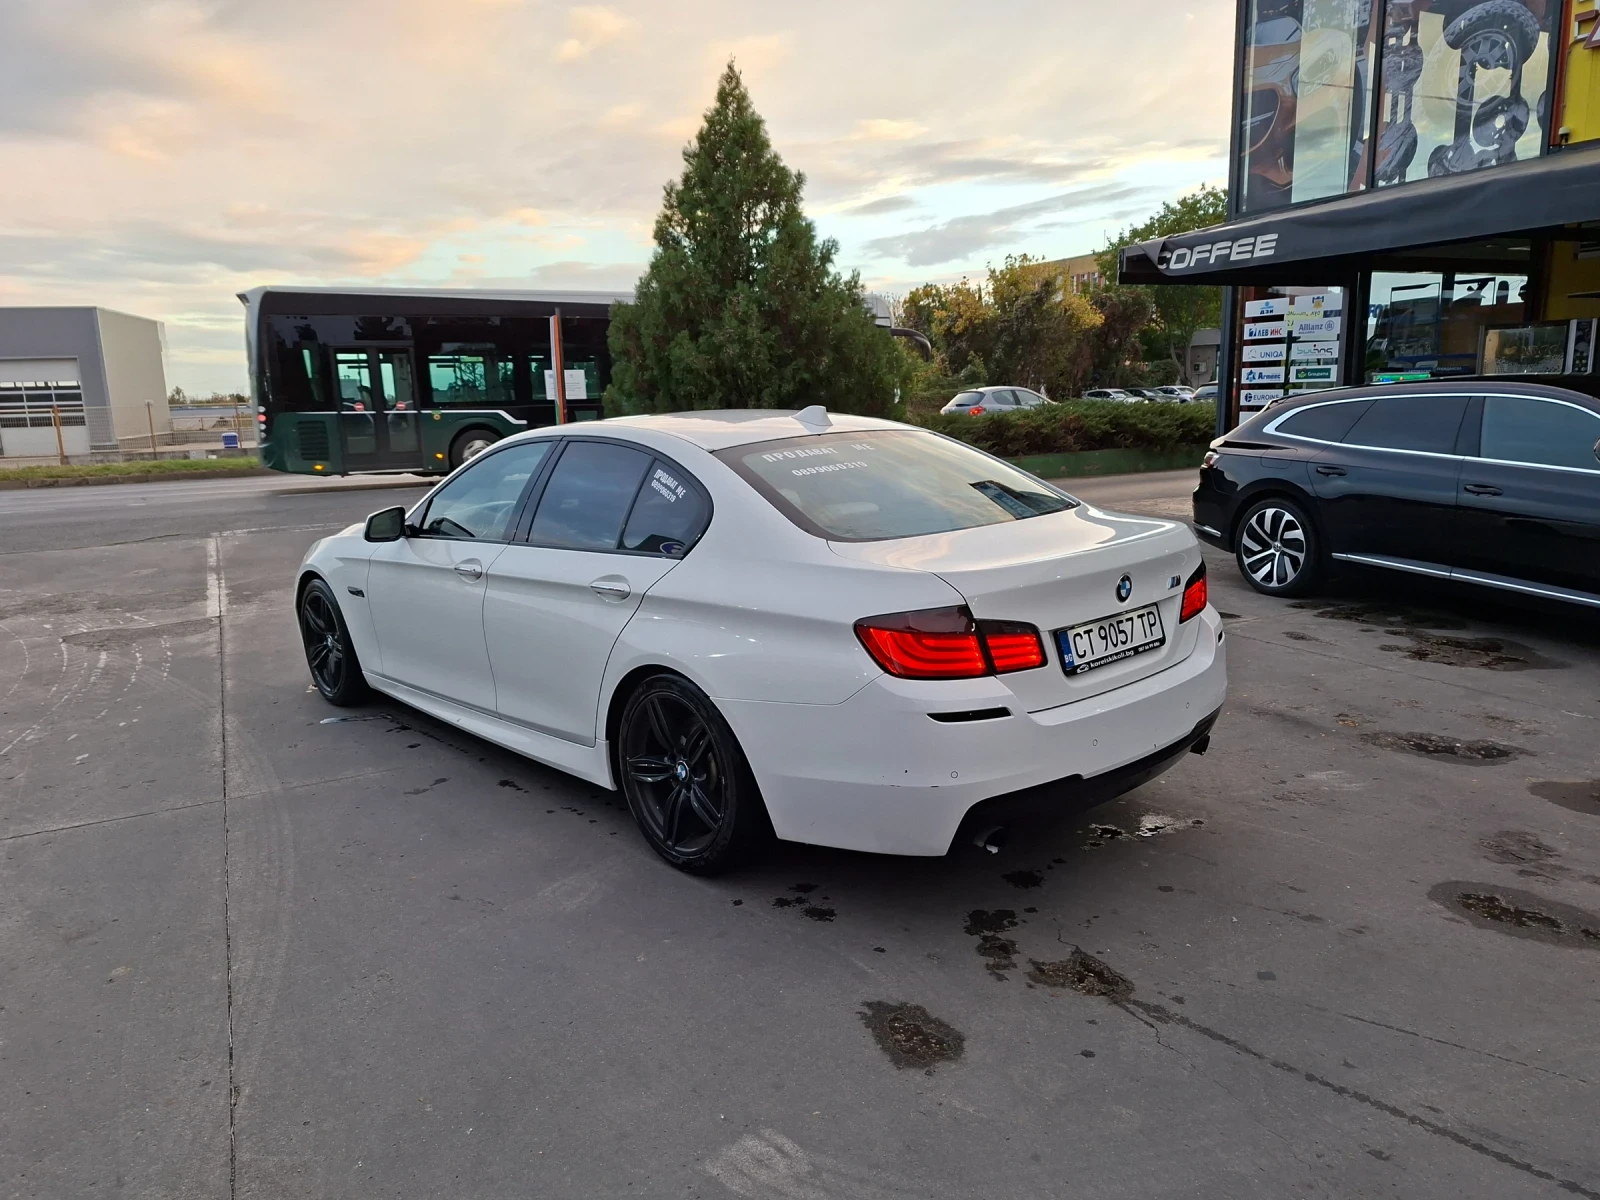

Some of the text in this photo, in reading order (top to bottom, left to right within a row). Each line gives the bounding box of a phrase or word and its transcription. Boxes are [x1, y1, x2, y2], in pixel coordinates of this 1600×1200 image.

[1299, 323, 1324, 331] Allianz
[1258, 328, 1282, 337] ЛЕВ ИНС
[1260, 350, 1283, 358] UNIQA
[791, 461, 868, 476] 0899060319
[1073, 610, 1157, 659] CT 9057 TP
[1064, 653, 1073, 663] BG
